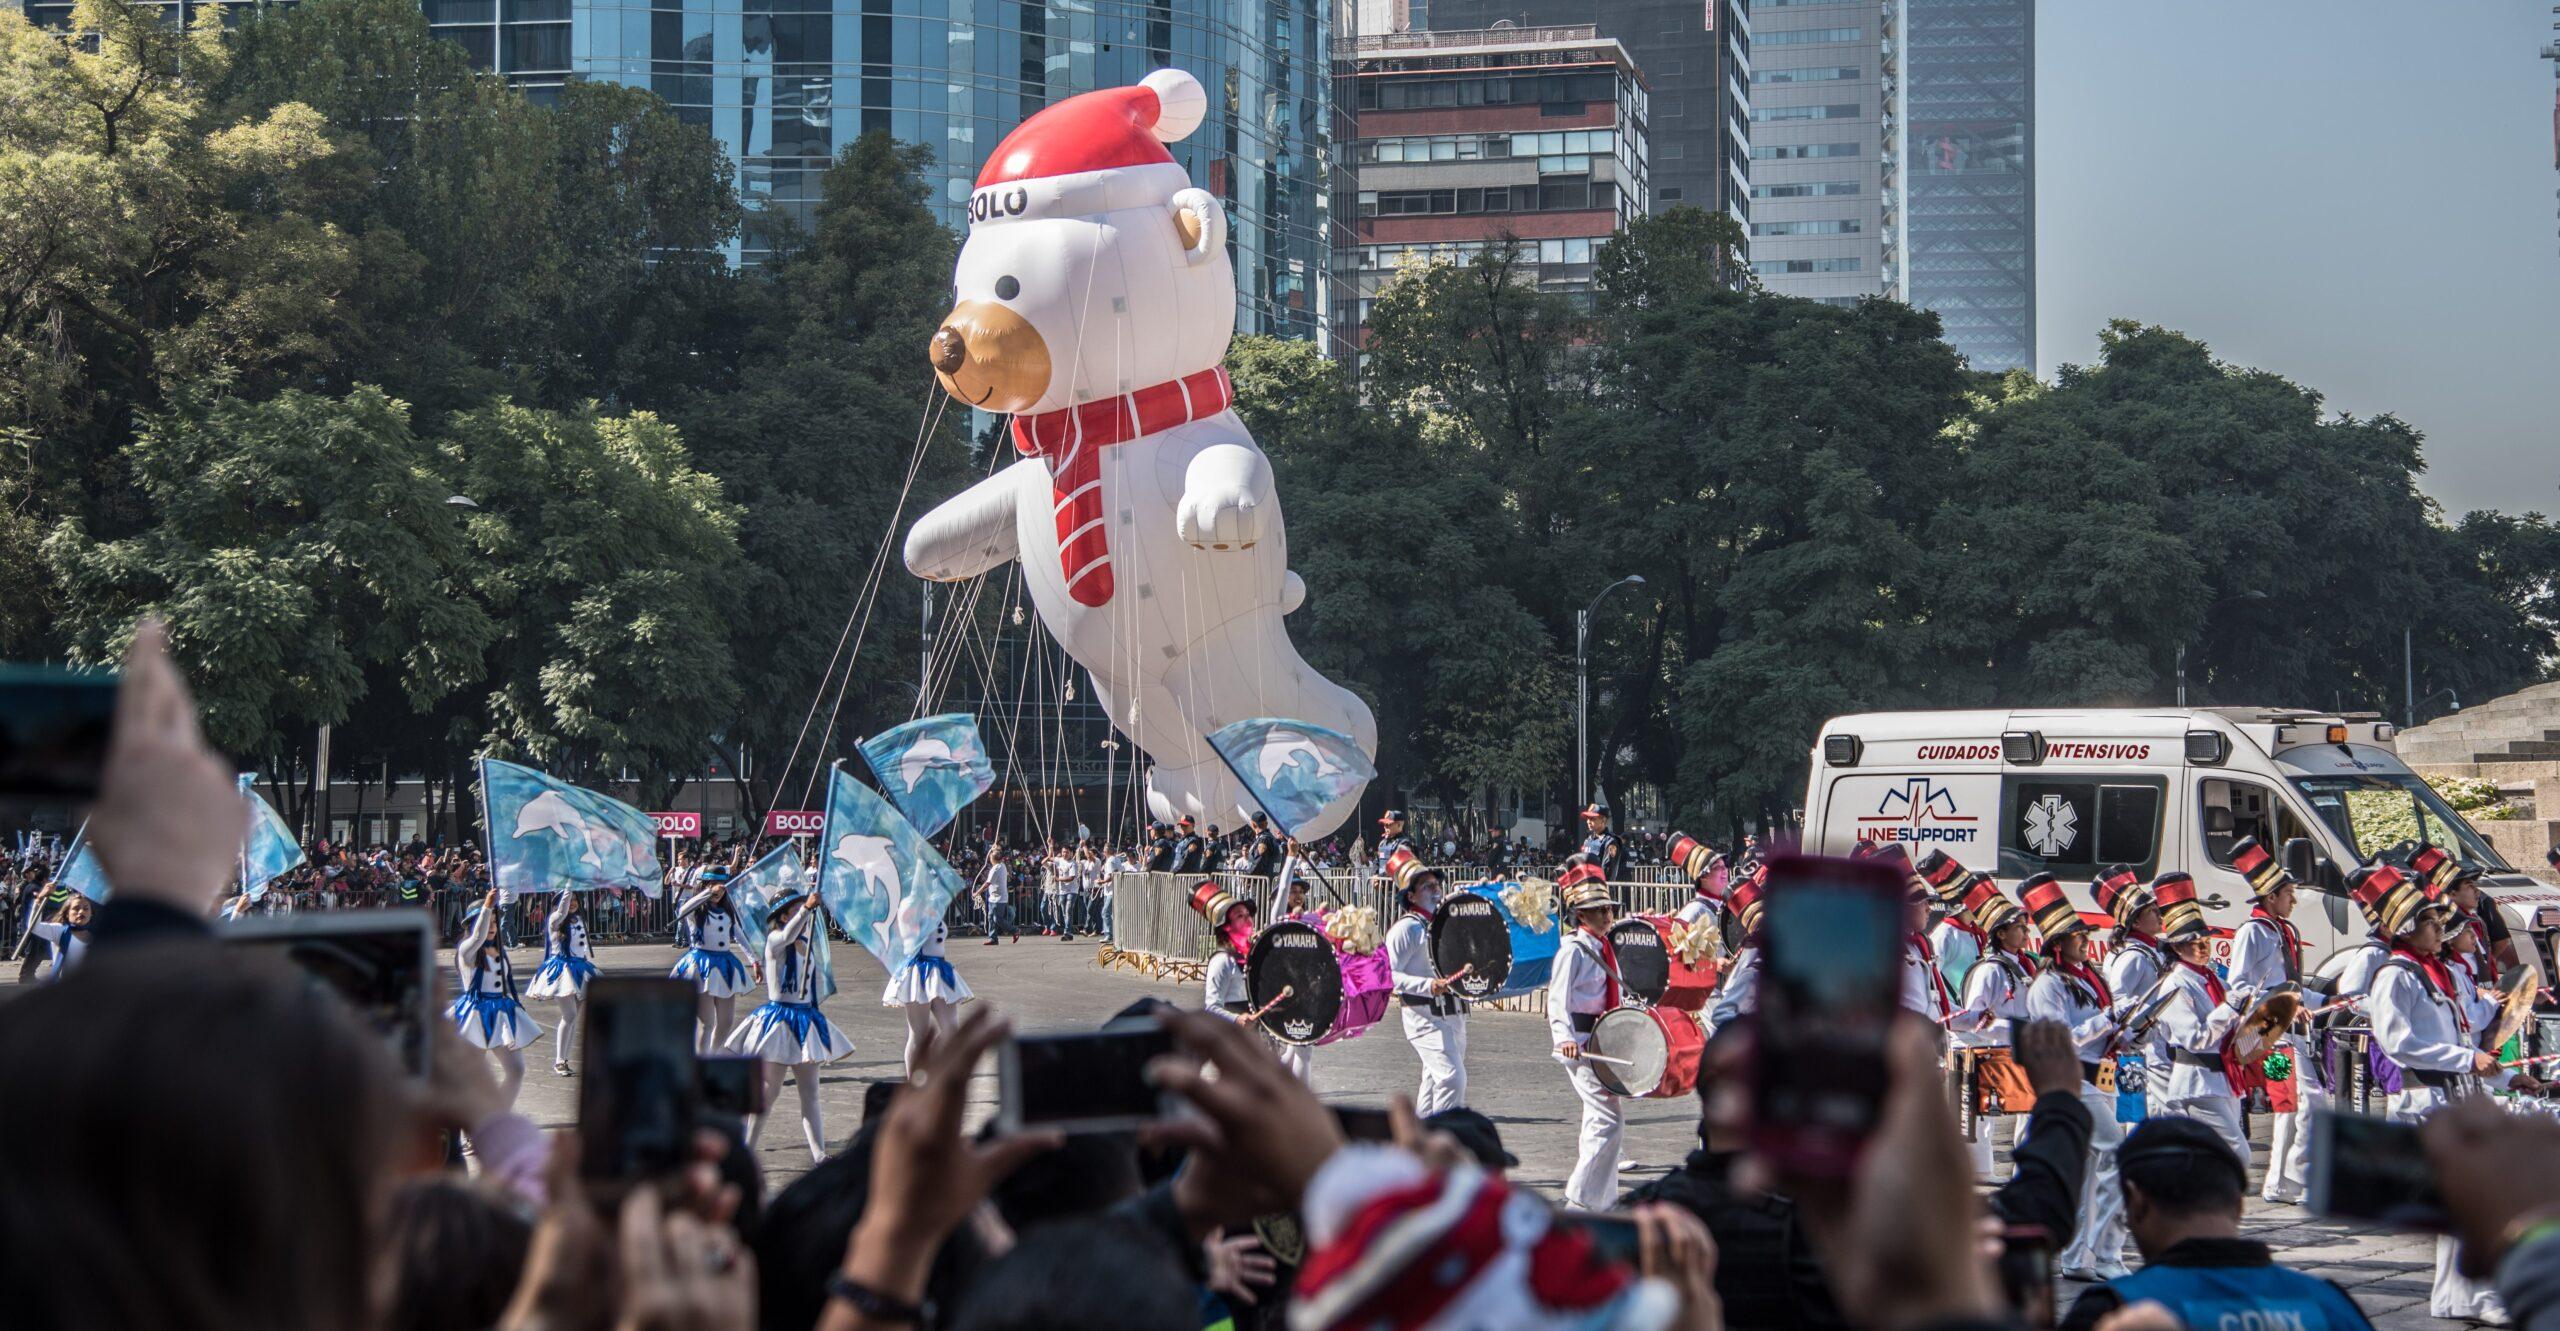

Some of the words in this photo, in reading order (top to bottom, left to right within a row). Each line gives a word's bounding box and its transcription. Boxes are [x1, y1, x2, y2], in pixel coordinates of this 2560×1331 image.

[968, 187, 1028, 224] BOLO
[1917, 745, 2000, 760] CUIDADOS
[2045, 744, 2151, 759] INTENSIVOS
[654, 816, 696, 831] BOLO
[775, 815, 825, 830] BOLO
[1857, 827, 1978, 842] LINESUPPORT
[1459, 902, 1491, 916] YAMAHA
[1282, 933, 1318, 949] YAMAHA
[1624, 932, 1658, 947] YAMAHA
